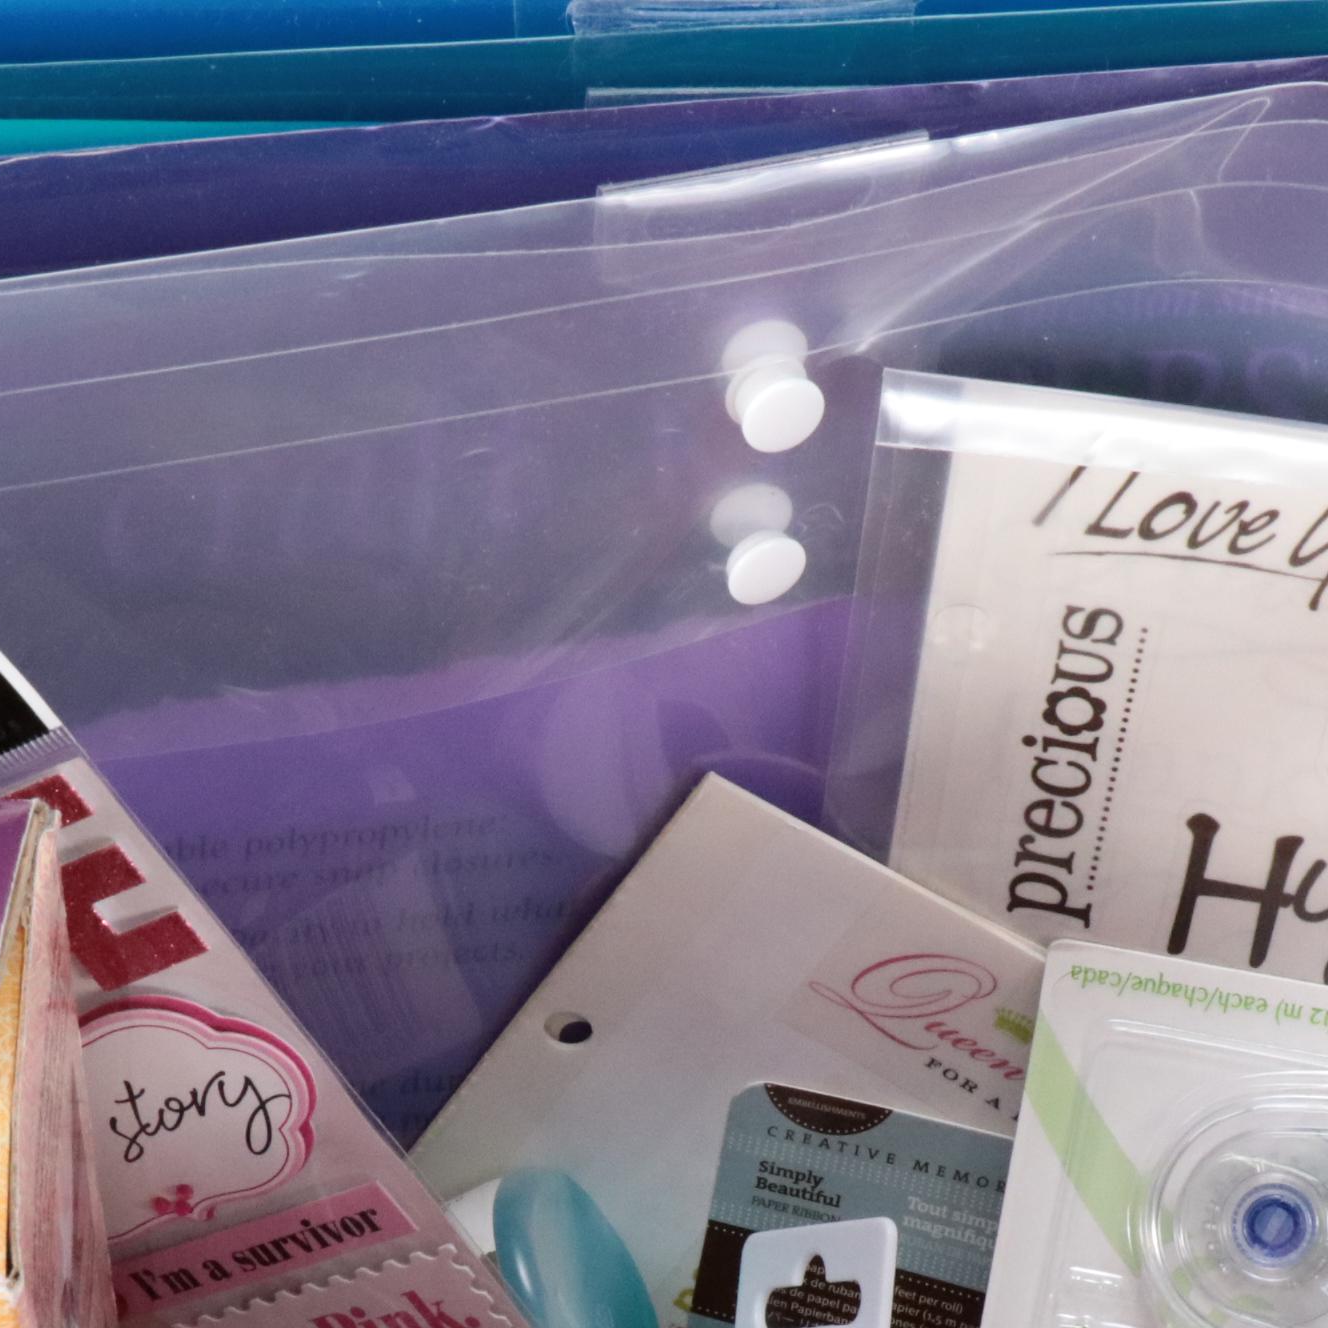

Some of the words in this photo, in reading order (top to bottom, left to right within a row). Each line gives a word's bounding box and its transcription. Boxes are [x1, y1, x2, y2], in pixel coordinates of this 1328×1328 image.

[1084, 468, 1278, 558] Love
[1006, 605, 1125, 928] precious
[1070, 963, 1269, 1015] each/chaque/cada
[1275, 1000, 1305, 1026] m)
[924, 1056, 979, 1095] FOR
[109, 1071, 293, 1165] story
[766, 1124, 897, 1166] CREATIVE
[754, 1175, 843, 1210] Beautiful
[758, 1160, 825, 1190] Simply
[751, 1195, 790, 1215] PAPER
[906, 1196, 948, 1219] Tout
[201, 1257, 233, 1283] a
[231, 1207, 383, 1274] survivor
[806, 1293, 839, 1310] papel
